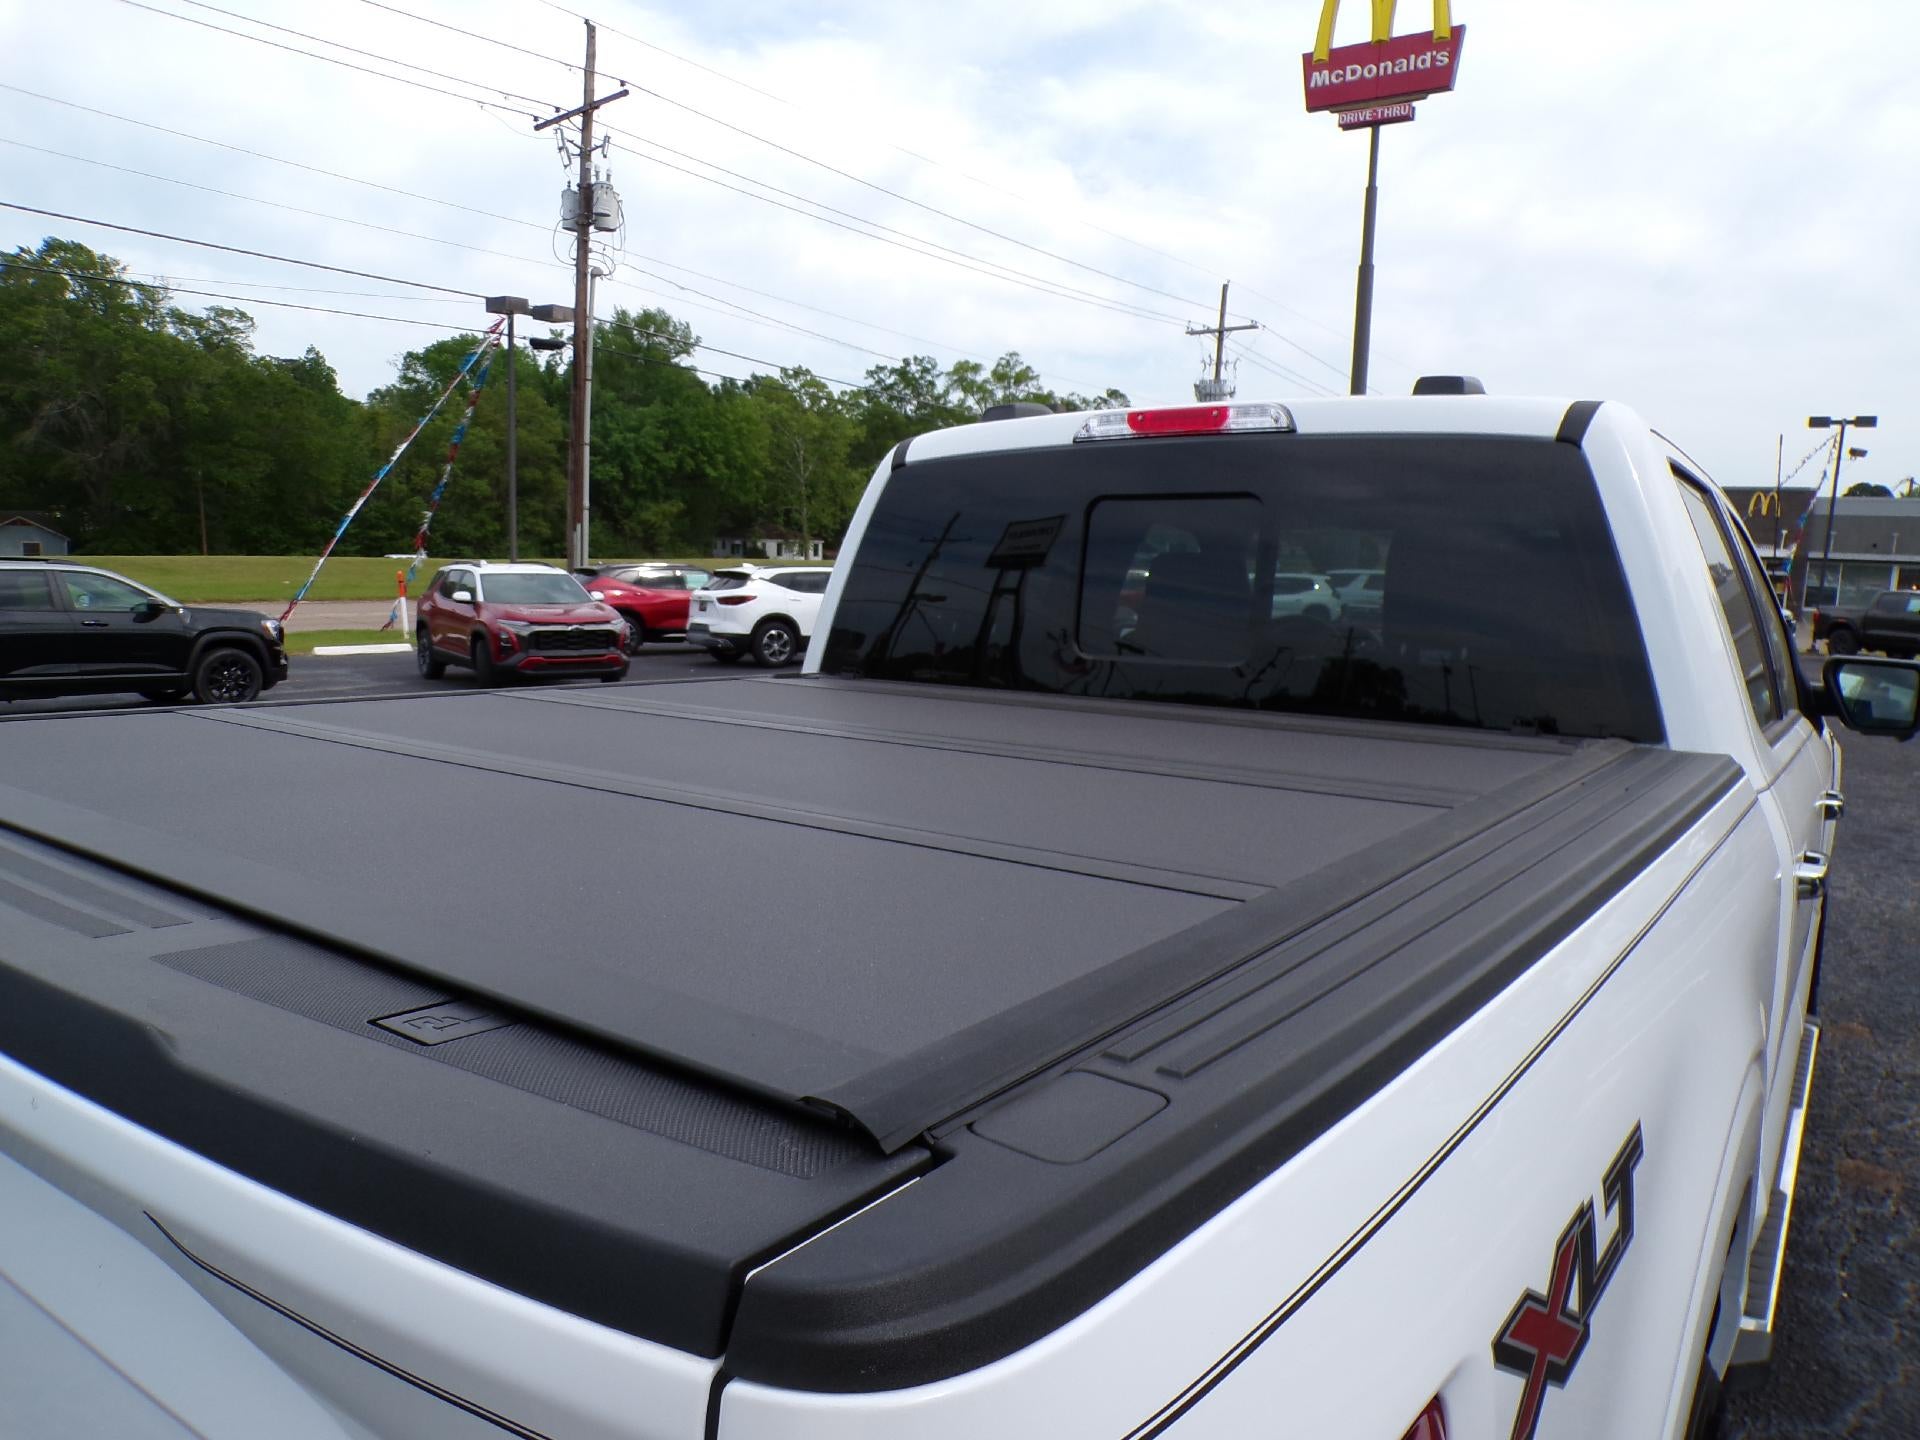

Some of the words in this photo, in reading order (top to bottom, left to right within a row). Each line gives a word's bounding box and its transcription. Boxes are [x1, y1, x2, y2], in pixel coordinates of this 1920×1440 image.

[1309, 49, 1450, 88] McDonald's
[1339, 104, 1410, 124] DRIVE-THRU
[1491, 1118, 1644, 1440] XLT
